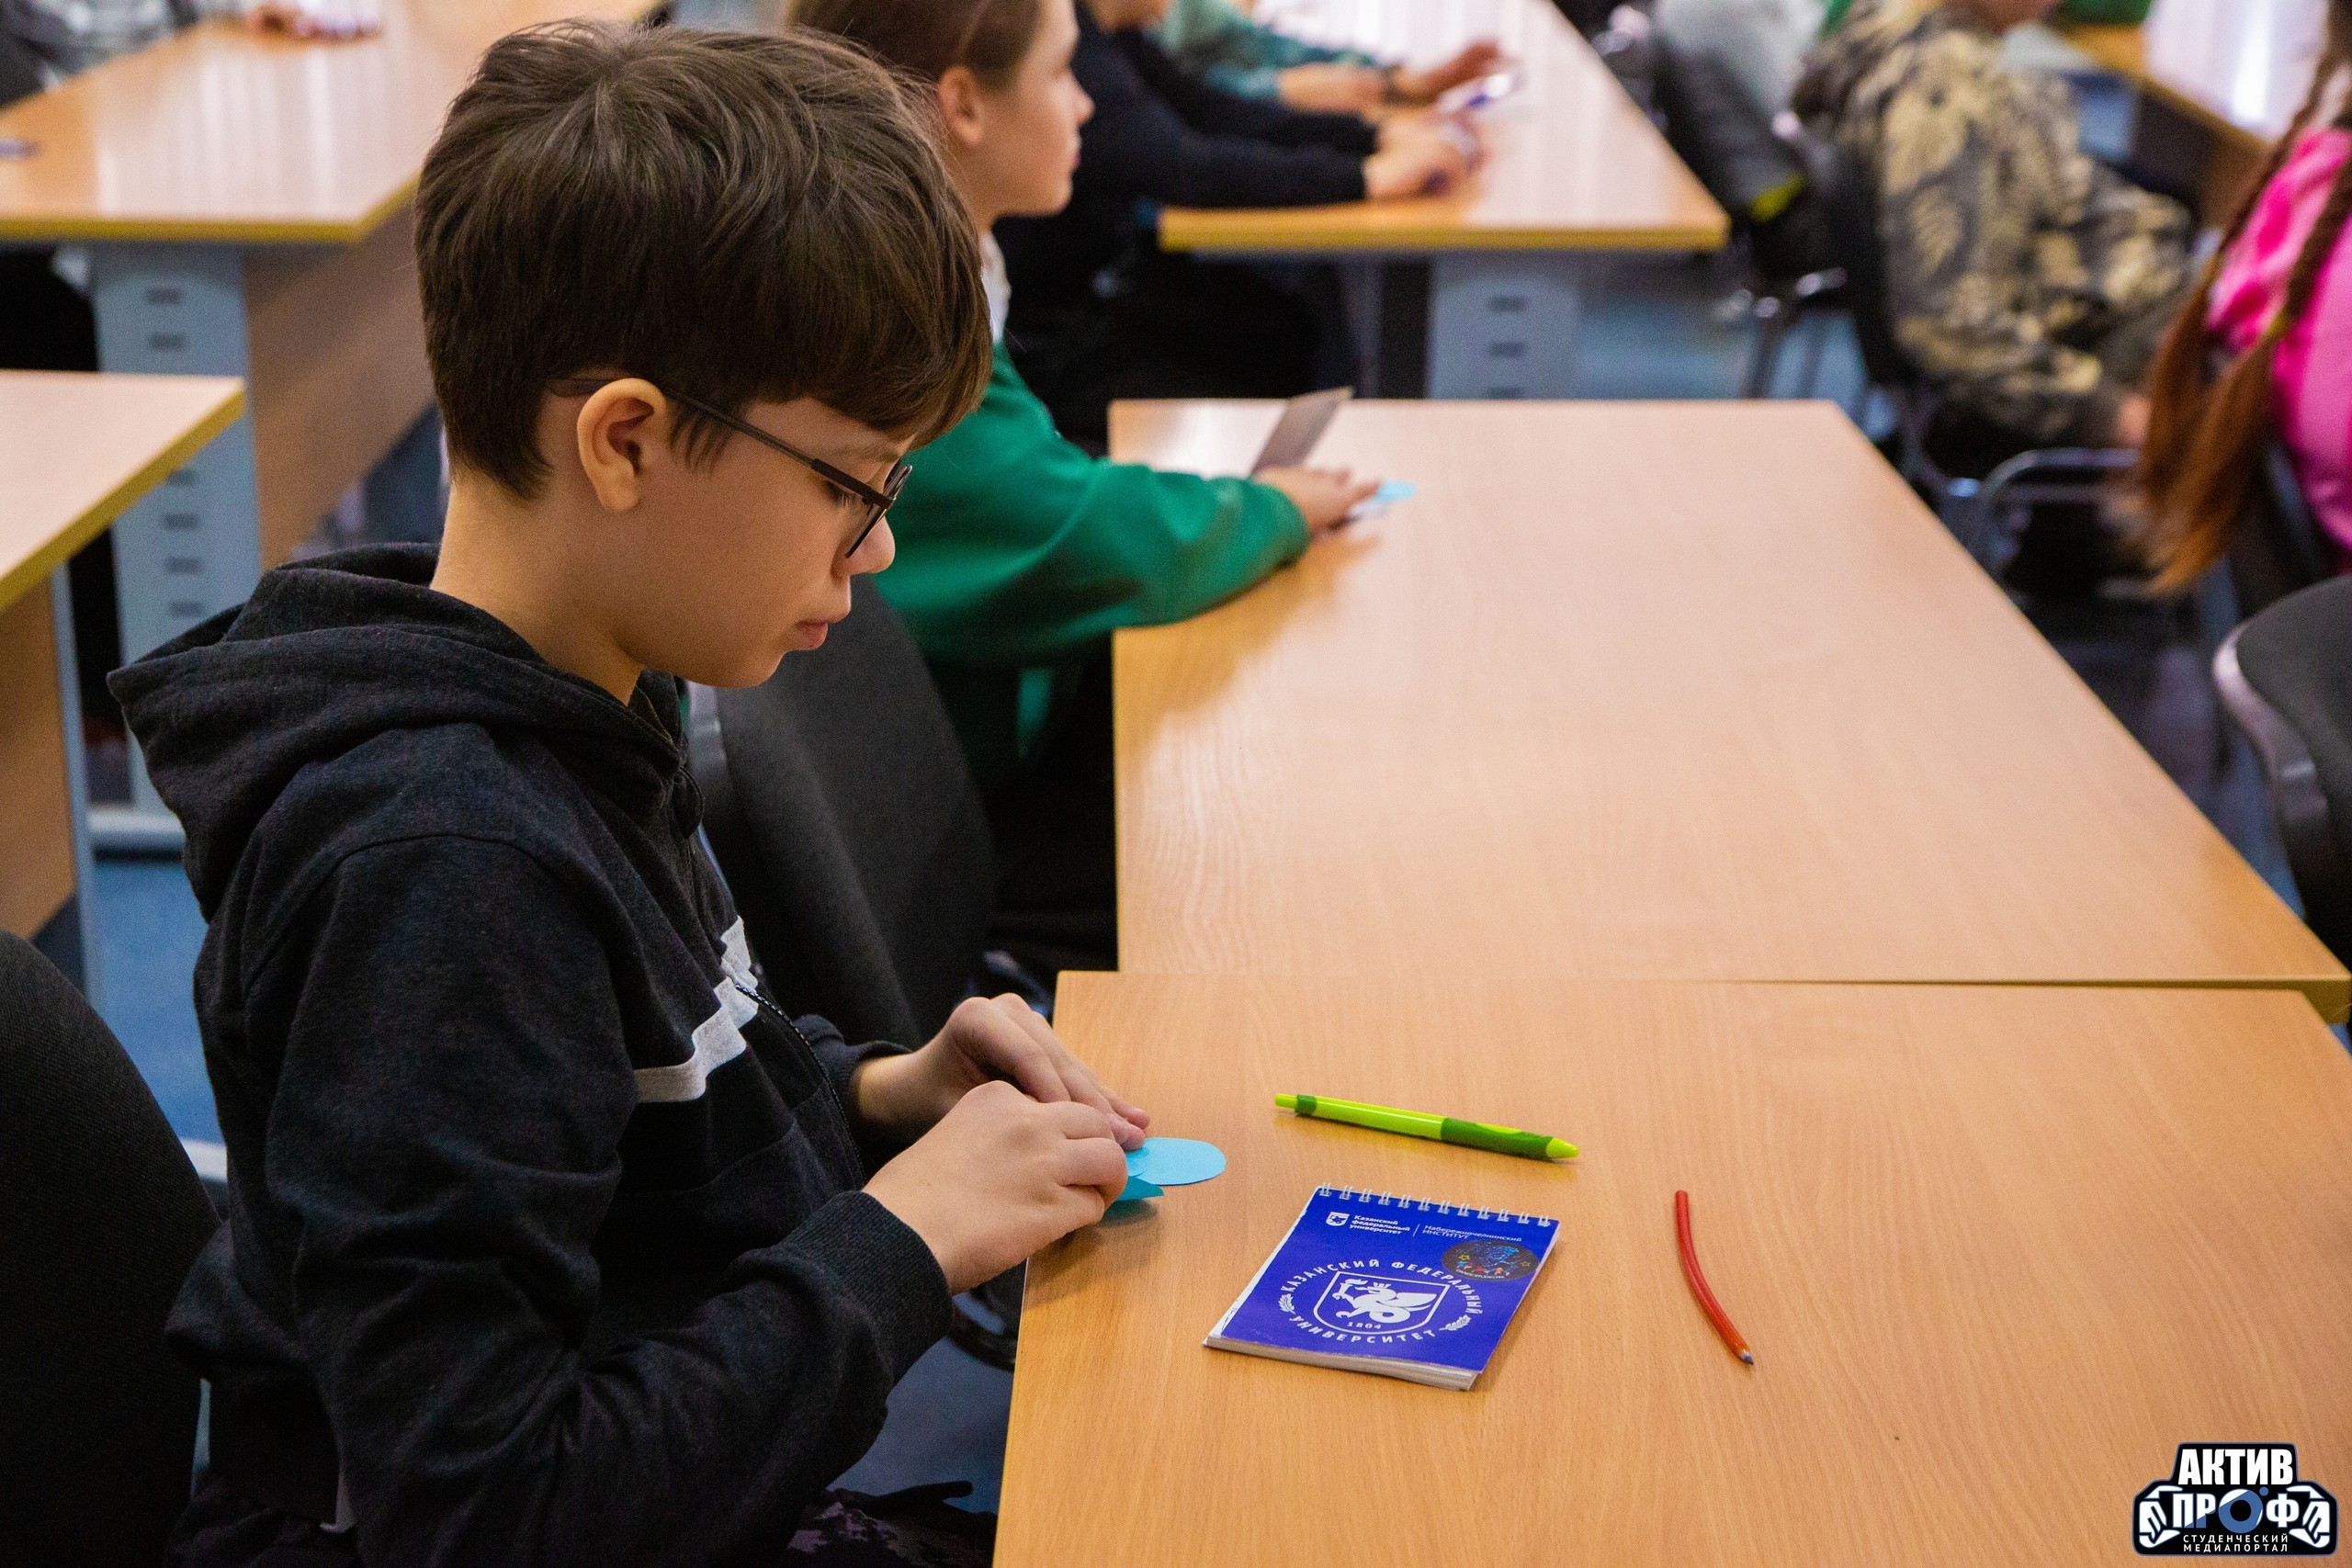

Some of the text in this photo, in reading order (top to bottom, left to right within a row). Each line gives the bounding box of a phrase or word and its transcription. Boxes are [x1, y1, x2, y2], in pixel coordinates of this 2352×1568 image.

[1351, 1220, 1410, 1231] федеральный
[1354, 1215, 1398, 1225] Казанский
[1350, 1224, 1402, 1235] университет
[1422, 1229, 1470, 1239] ИНСТИТУТ
[1281, 1258, 1483, 1314] КАЗАНСКИЙ ФЕДЕРАЛЬНЫЙ
[1289, 1315, 1435, 1344] УНИВЕРСИТЕТ
